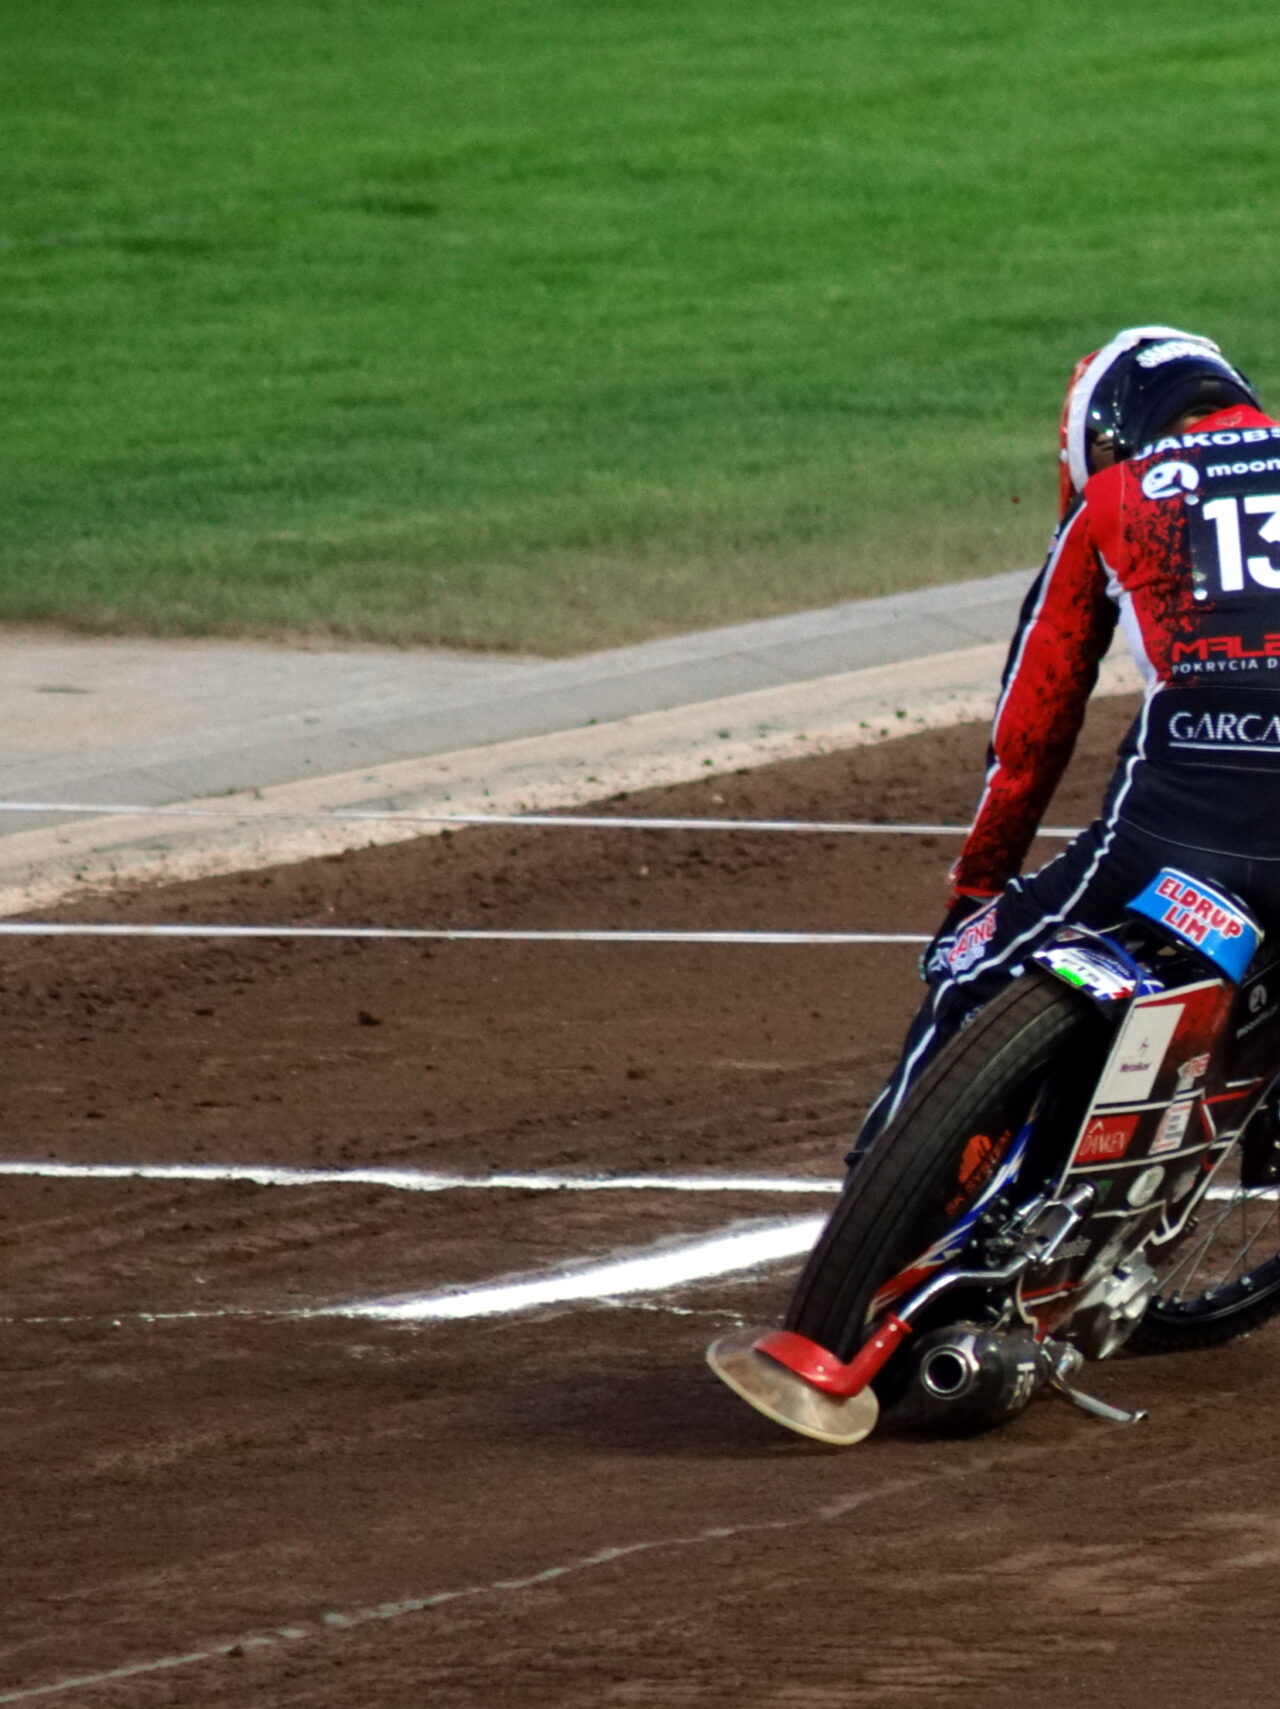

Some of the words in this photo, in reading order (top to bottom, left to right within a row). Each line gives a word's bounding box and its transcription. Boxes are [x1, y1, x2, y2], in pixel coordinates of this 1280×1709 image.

[1172, 660, 1258, 676] POKRYCIA
[1156, 877, 1244, 939] ELDRUP
[1162, 905, 1209, 945] LIM
